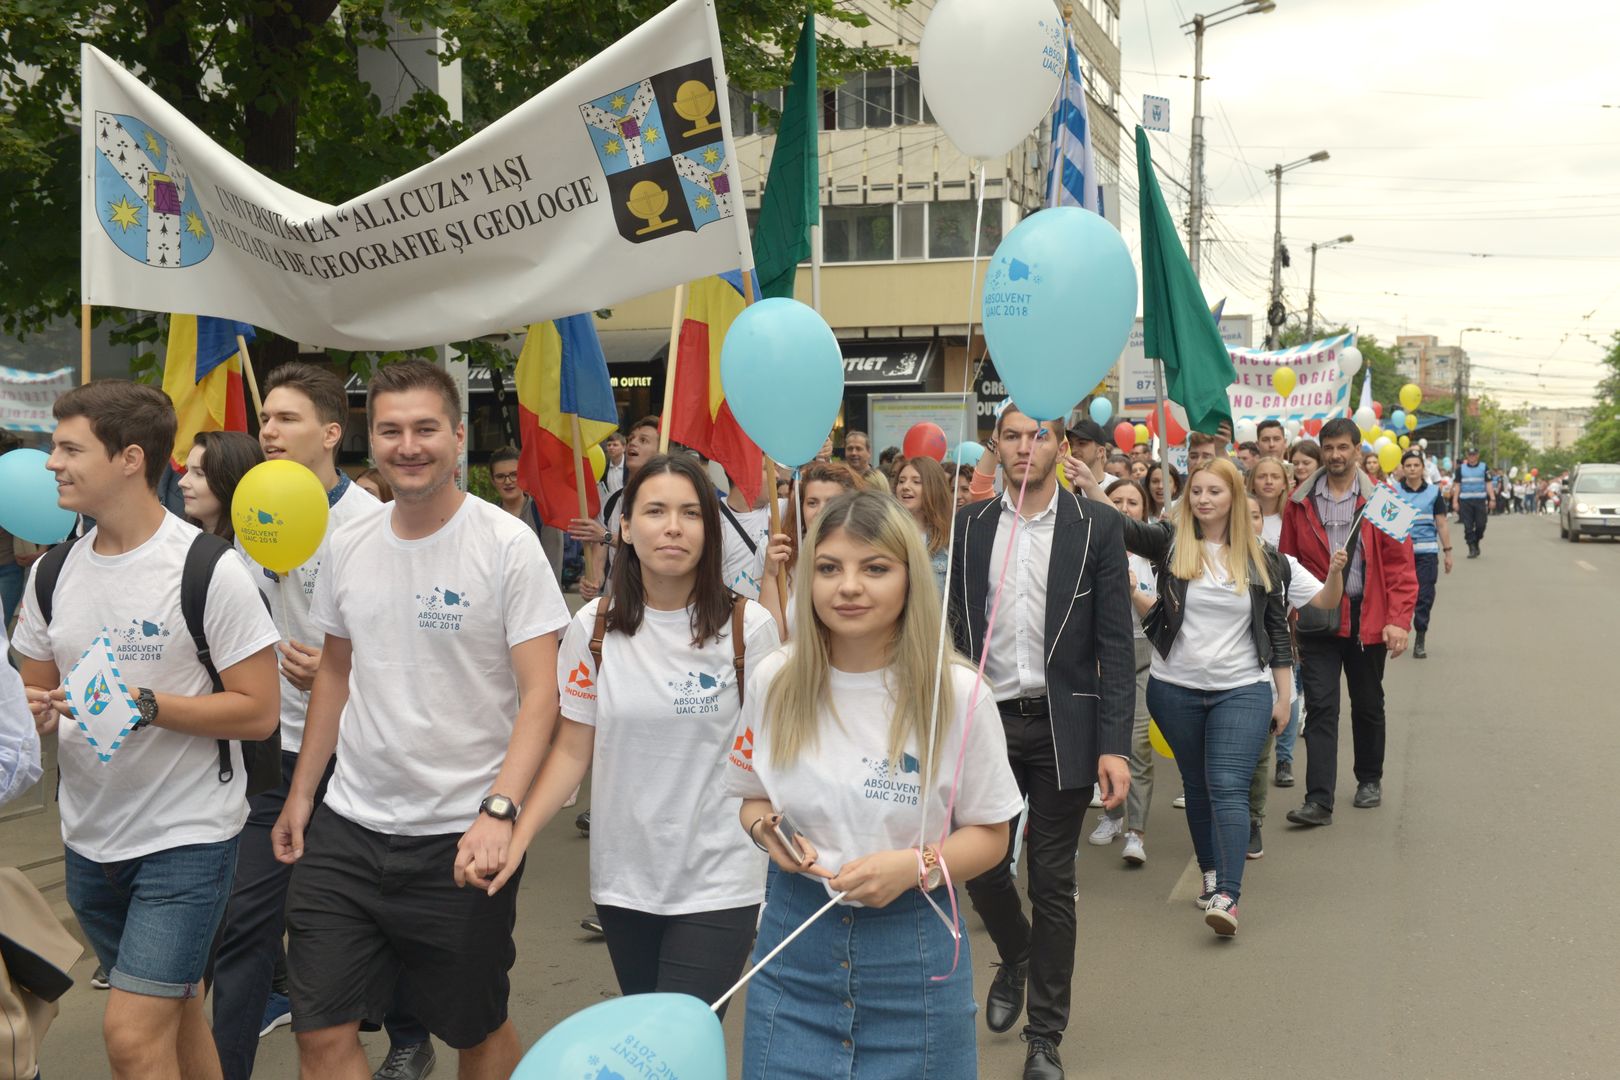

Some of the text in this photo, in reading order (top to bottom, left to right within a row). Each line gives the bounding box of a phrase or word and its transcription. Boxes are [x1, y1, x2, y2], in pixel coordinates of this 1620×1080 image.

[214, 185, 340, 243] UNIVERSITATEA
[207, 210, 289, 271] FACULTATEA
[284, 249, 313, 276] DE
[310, 228, 447, 280] GEOGRAFIE
[473, 176, 599, 241] GEOLOGIE
[985, 292, 1032, 304] ABSOLVENT
[1004, 305, 1028, 317] 2018
[1230, 349, 1336, 367] FACULTATEA
[620, 376, 652, 388] OUTLET
[1256, 368, 1336, 387] TEOGIE
[982, 380, 1008, 395] CRE
[1229, 388, 1333, 408] NO-CATOLICĂ
[259, 536, 278, 544] 2018
[417, 611, 464, 622] ABSOLVENT
[419, 620, 460, 631] UAIC 2018
[117, 644, 164, 652] ABSOLVENT
[119, 653, 161, 661] UAIC 2018
[673, 695, 719, 706] ABSOLVENT
[676, 704, 719, 715] UAIC 2018
[864, 778, 921, 795] ABSOLVENT
[865, 789, 918, 806] UAIC 2018
[624, 1034, 657, 1063] 2018
[609, 1041, 661, 1080] OLVENT
